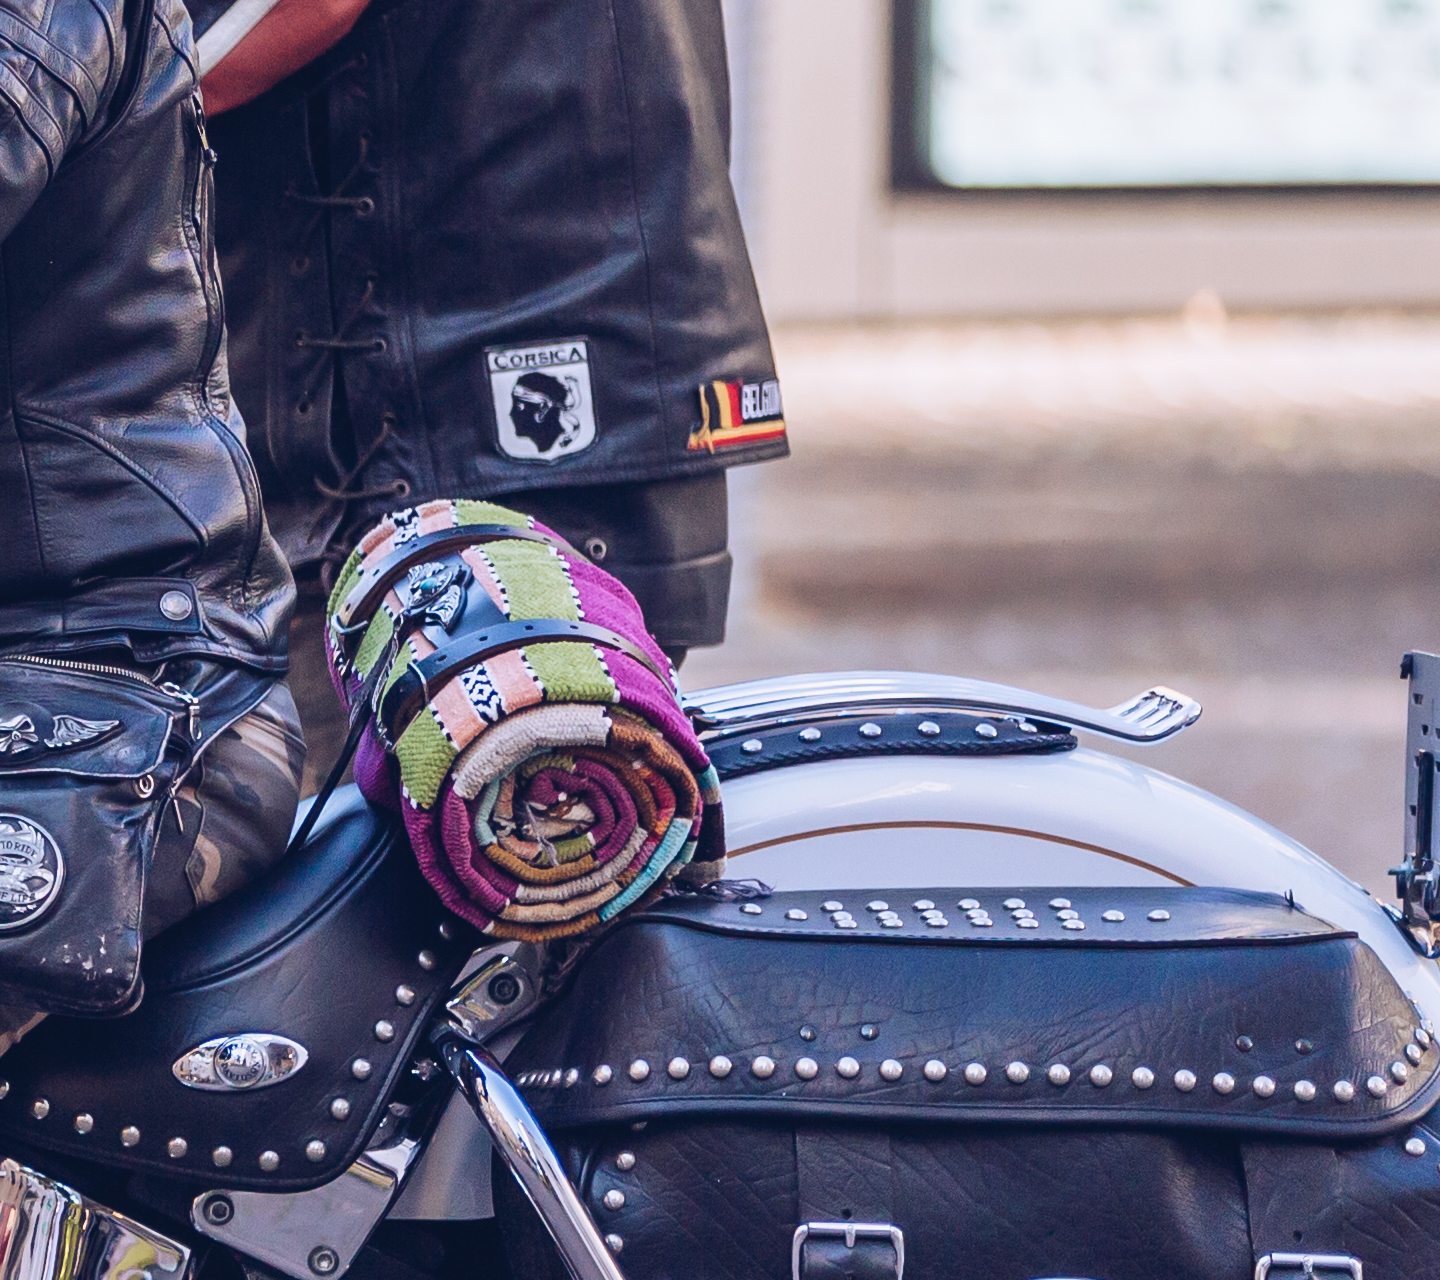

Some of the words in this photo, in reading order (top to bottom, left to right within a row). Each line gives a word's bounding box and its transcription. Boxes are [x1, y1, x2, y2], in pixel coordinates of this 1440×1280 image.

[494, 347, 584, 369] CORSICA
[1, 840, 12, 850] TO
[15, 842, 38, 858] RIDE
[11, 893, 36, 903] LIFE
